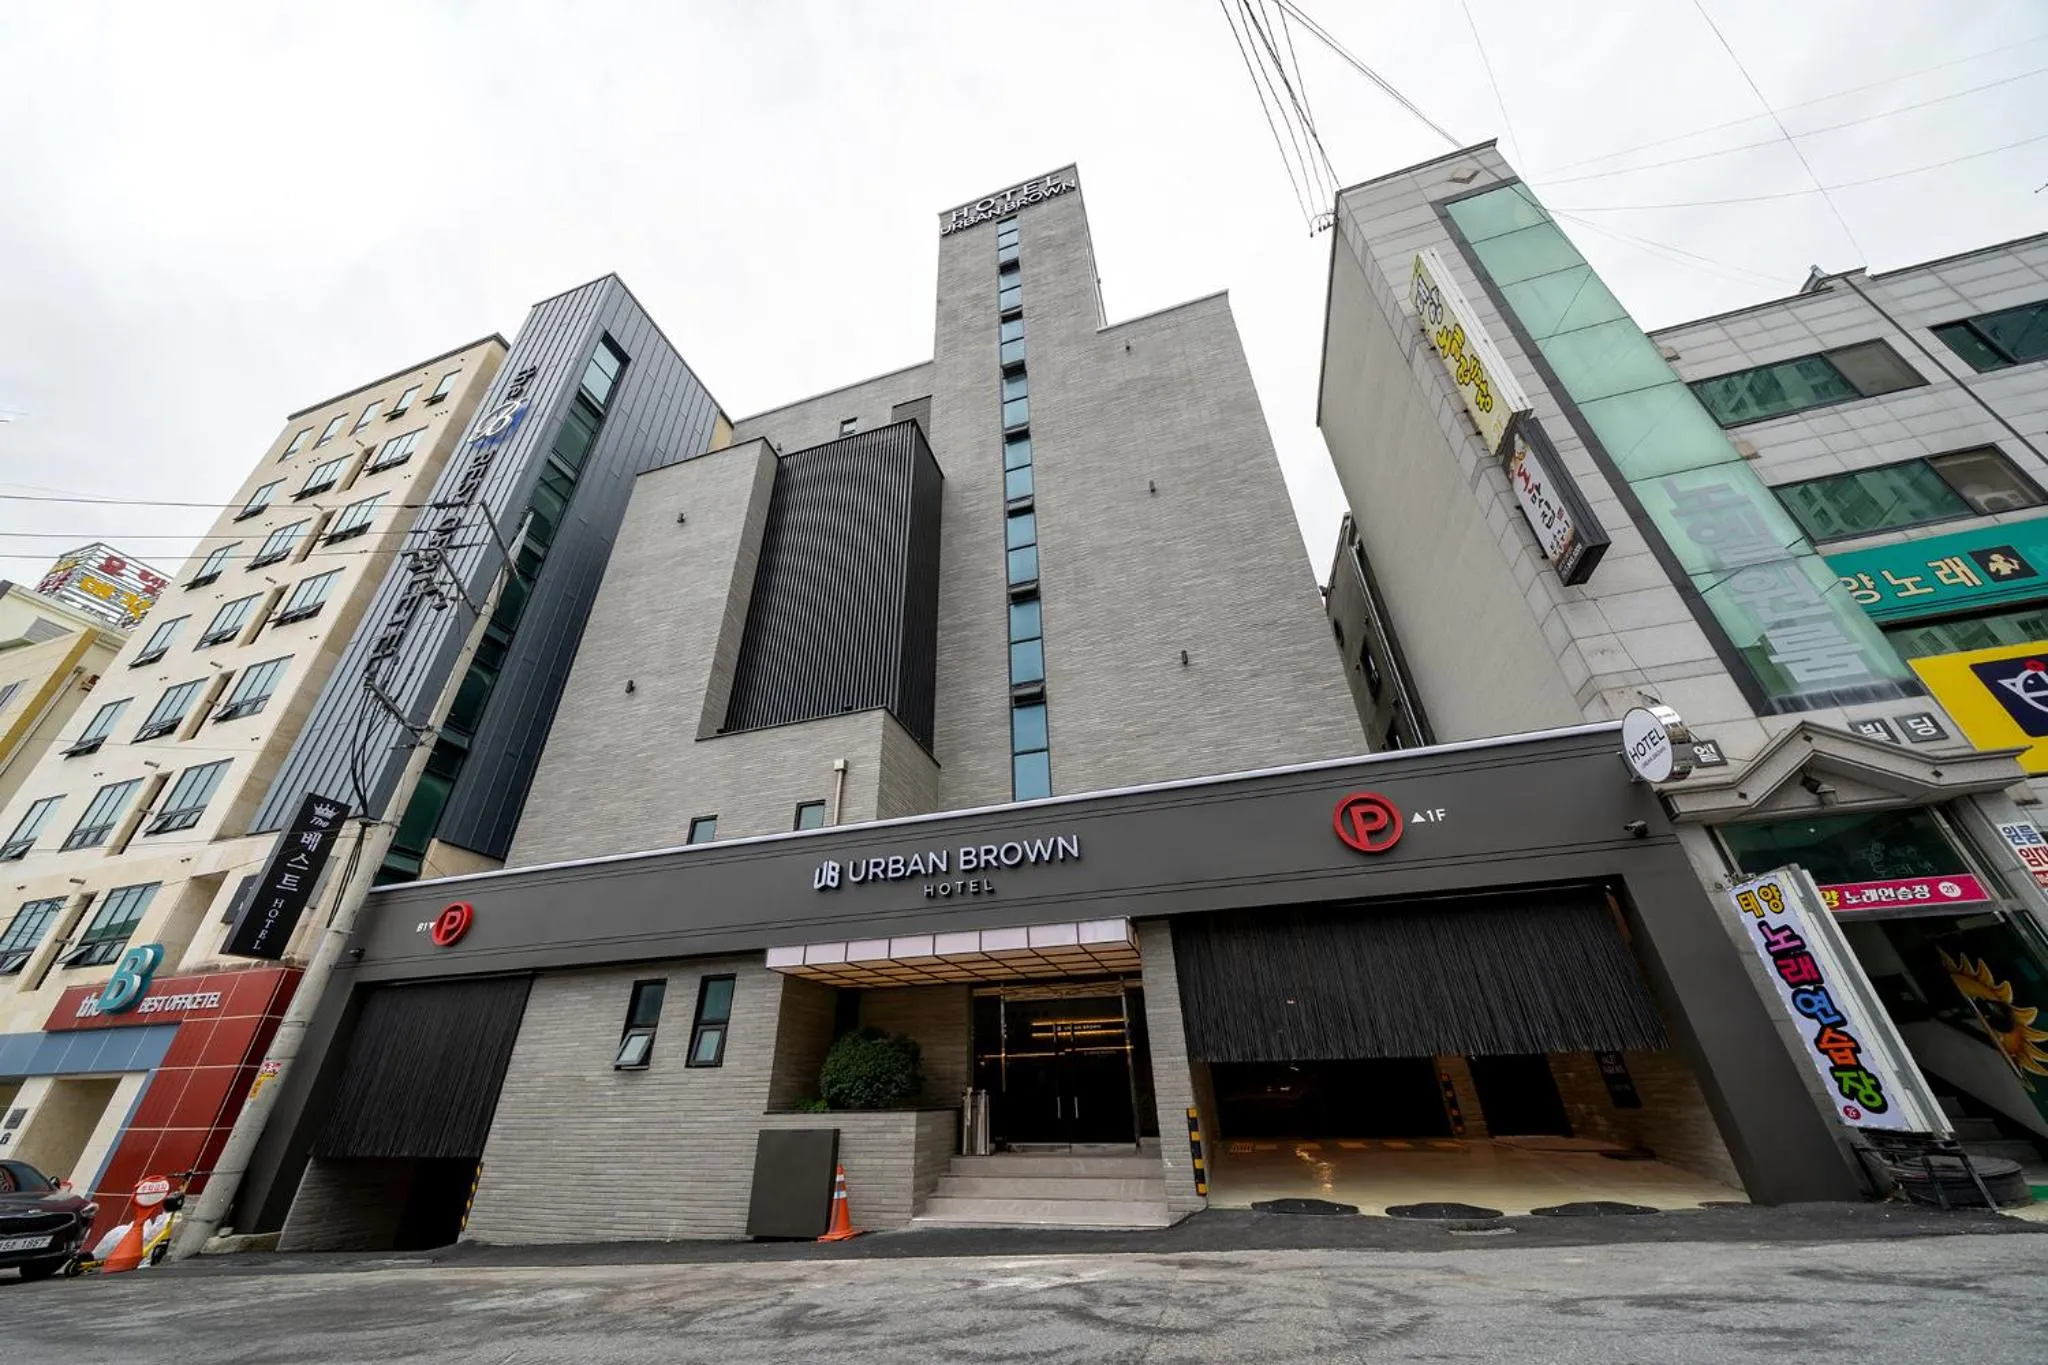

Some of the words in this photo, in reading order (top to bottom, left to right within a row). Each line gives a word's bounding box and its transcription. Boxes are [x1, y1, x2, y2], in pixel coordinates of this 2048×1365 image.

[940, 207, 1001, 236] URBAN
[1003, 179, 1076, 214] BROWN
[951, 175, 1061, 222] HOTEL
[506, 366, 538, 401] the
[1629, 727, 1665, 764] HOTEL
[309, 815, 330, 828] The
[1426, 808, 1447, 822] 1F
[276, 831, 323, 892] 베스트
[848, 849, 949, 883] URBAN
[958, 834, 1080, 871] BROWN
[923, 878, 995, 897] HOTEL
[1736, 882, 1786, 919] 태양
[1844, 884, 1931, 904] 노래연습장
[252, 897, 284, 950] HOTEL
[100, 943, 156, 1012] B
[137, 996, 168, 1014] BEST
[163, 991, 221, 1012] OFFICETEL
[1757, 920, 1889, 1114] 노래연습장
